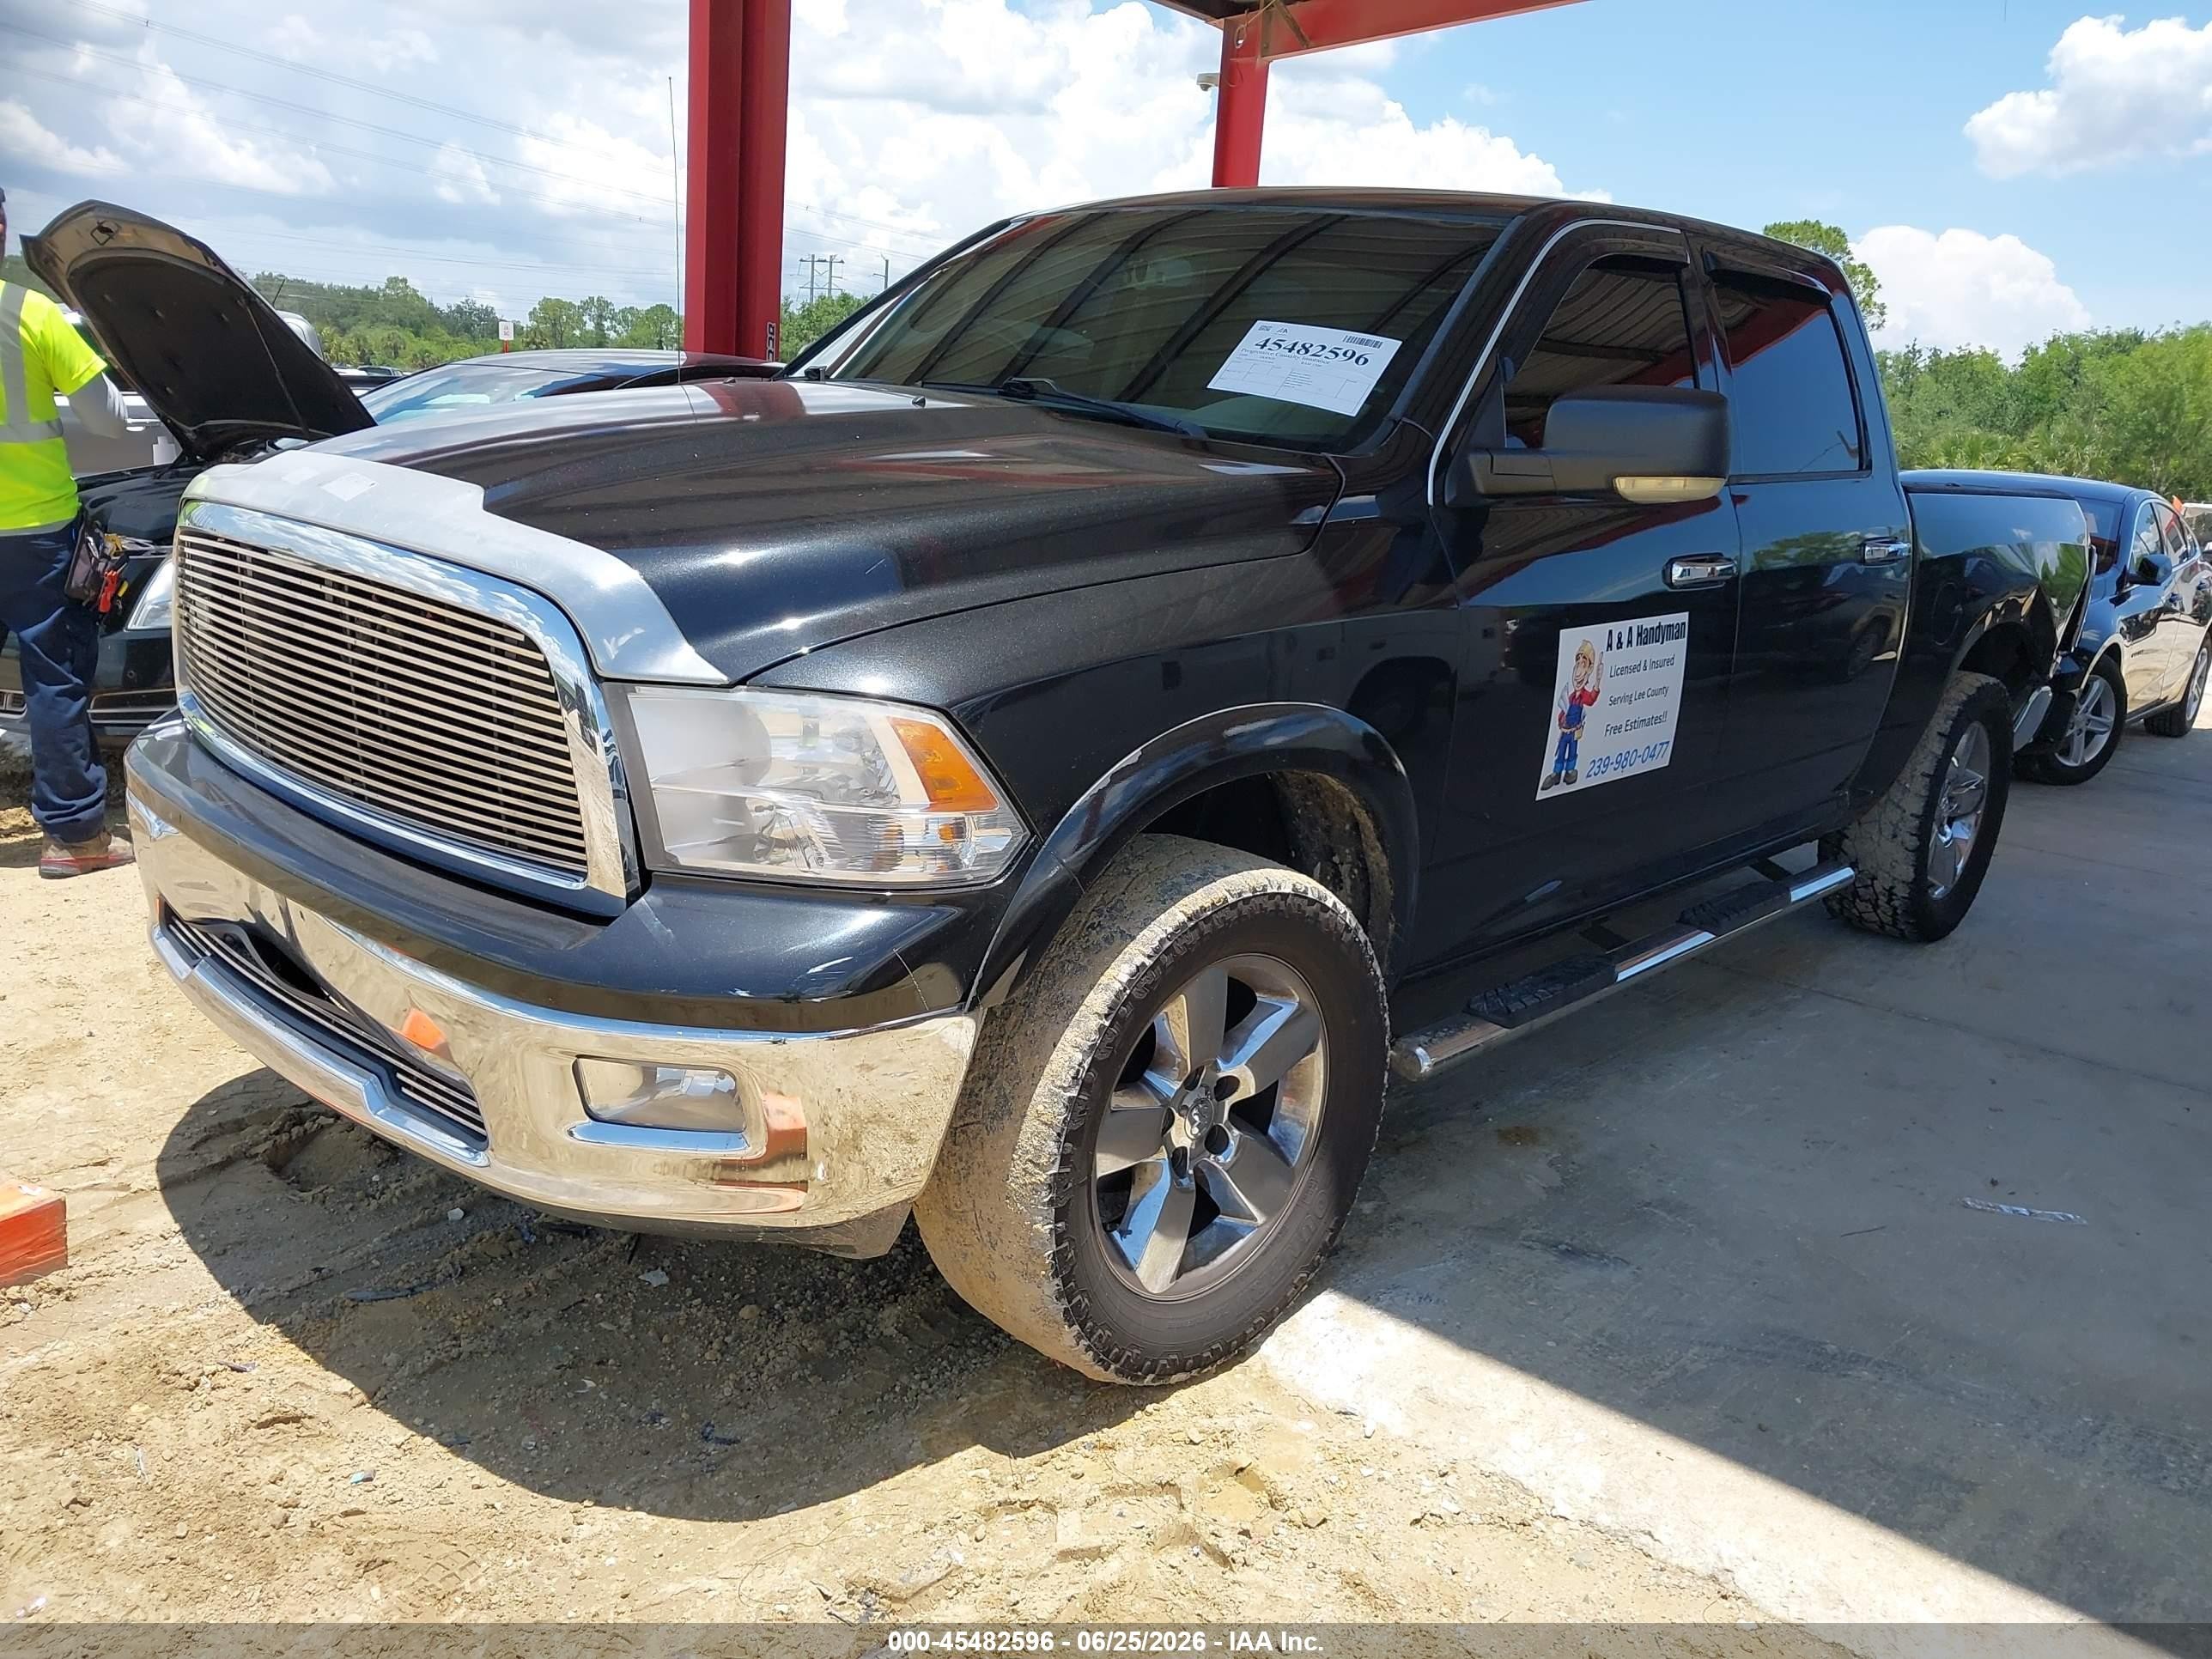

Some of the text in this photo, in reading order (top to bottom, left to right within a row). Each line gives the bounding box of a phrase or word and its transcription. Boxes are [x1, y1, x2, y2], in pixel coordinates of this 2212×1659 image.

[1255, 337, 1374, 366] 45482596
[1606, 621, 1686, 652] A & A Handyman
[1609, 654, 1675, 678] Licensed & Insured
[1608, 685, 1669, 706] Serving Lee County
[1604, 711, 1668, 737] Free Estimates!!
[1586, 741, 1670, 779] 239-980-0477
